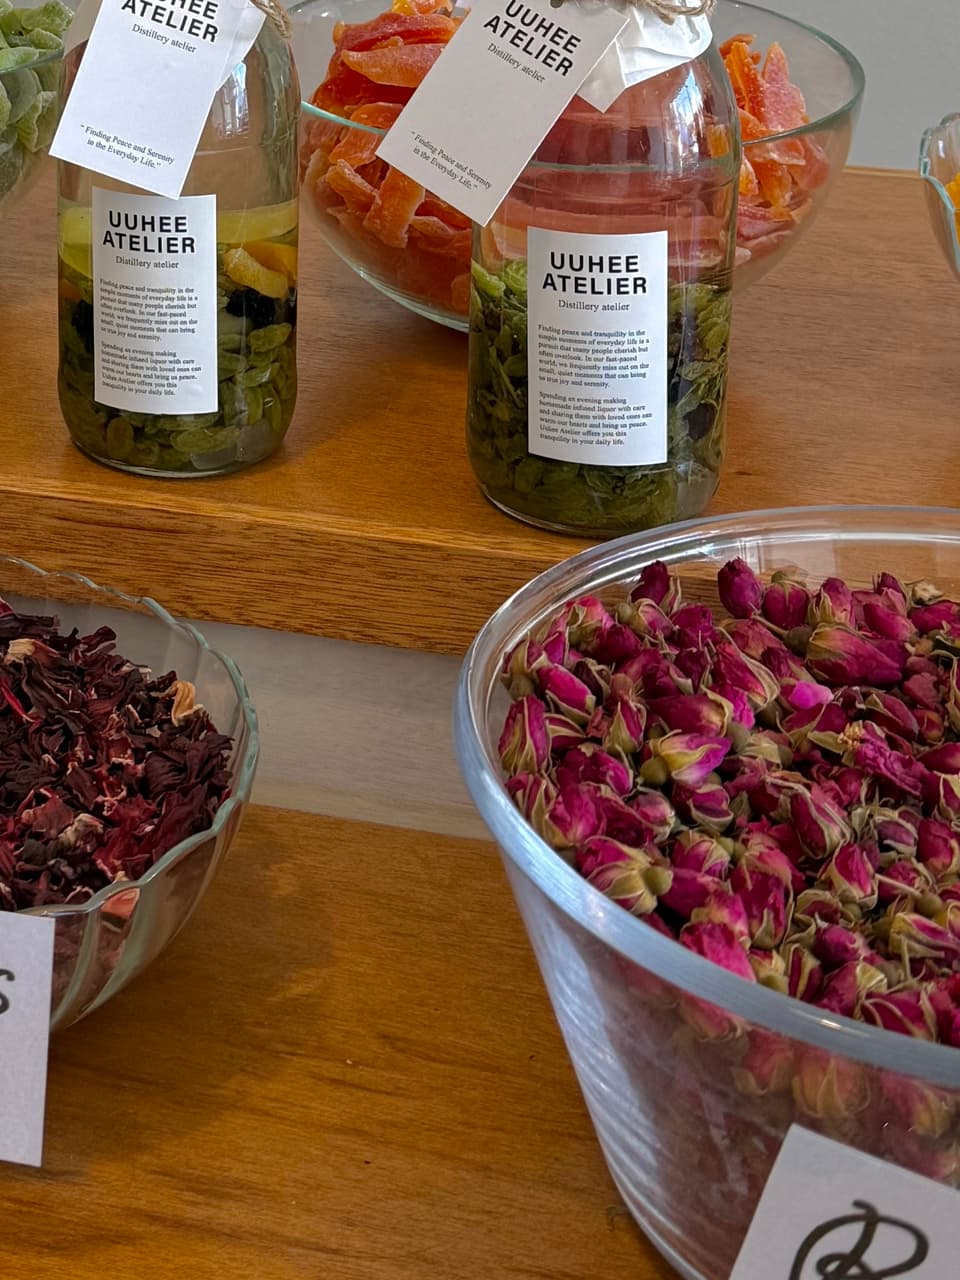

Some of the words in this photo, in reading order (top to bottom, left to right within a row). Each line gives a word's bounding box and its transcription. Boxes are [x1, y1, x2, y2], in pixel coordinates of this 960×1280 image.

[132, 23, 169, 45] Distillery
[170, 38, 196, 53] atelier
[505, 0, 581, 54] UUHEE
[483, 15, 574, 77] ATELIER
[487, 43, 521, 69] Distillery
[521, 66, 545, 83] atelier
[87, 138, 95, 146] in
[95, 141, 106, 151] the
[107, 145, 139, 164] Everyday
[112, 135, 132, 149] Peace
[132, 145, 146, 154] and
[147, 148, 175, 164] Serenity
[413, 147, 420, 155] in
[420, 151, 430, 161] the
[430, 157, 457, 180] Everyday
[437, 149, 455, 165] Peace
[454, 161, 468, 173] and
[466, 168, 492, 189] Serenity
[109, 210, 187, 233] UUHEE
[103, 230, 195, 254] ATELIER
[116, 256, 151, 269] Distillery
[153, 261, 179, 269] atelier
[550, 251, 639, 273] UUHEE
[542, 273, 647, 295] ATELIER
[558, 299, 600, 312] Distillery
[601, 302, 630, 311] atelier
